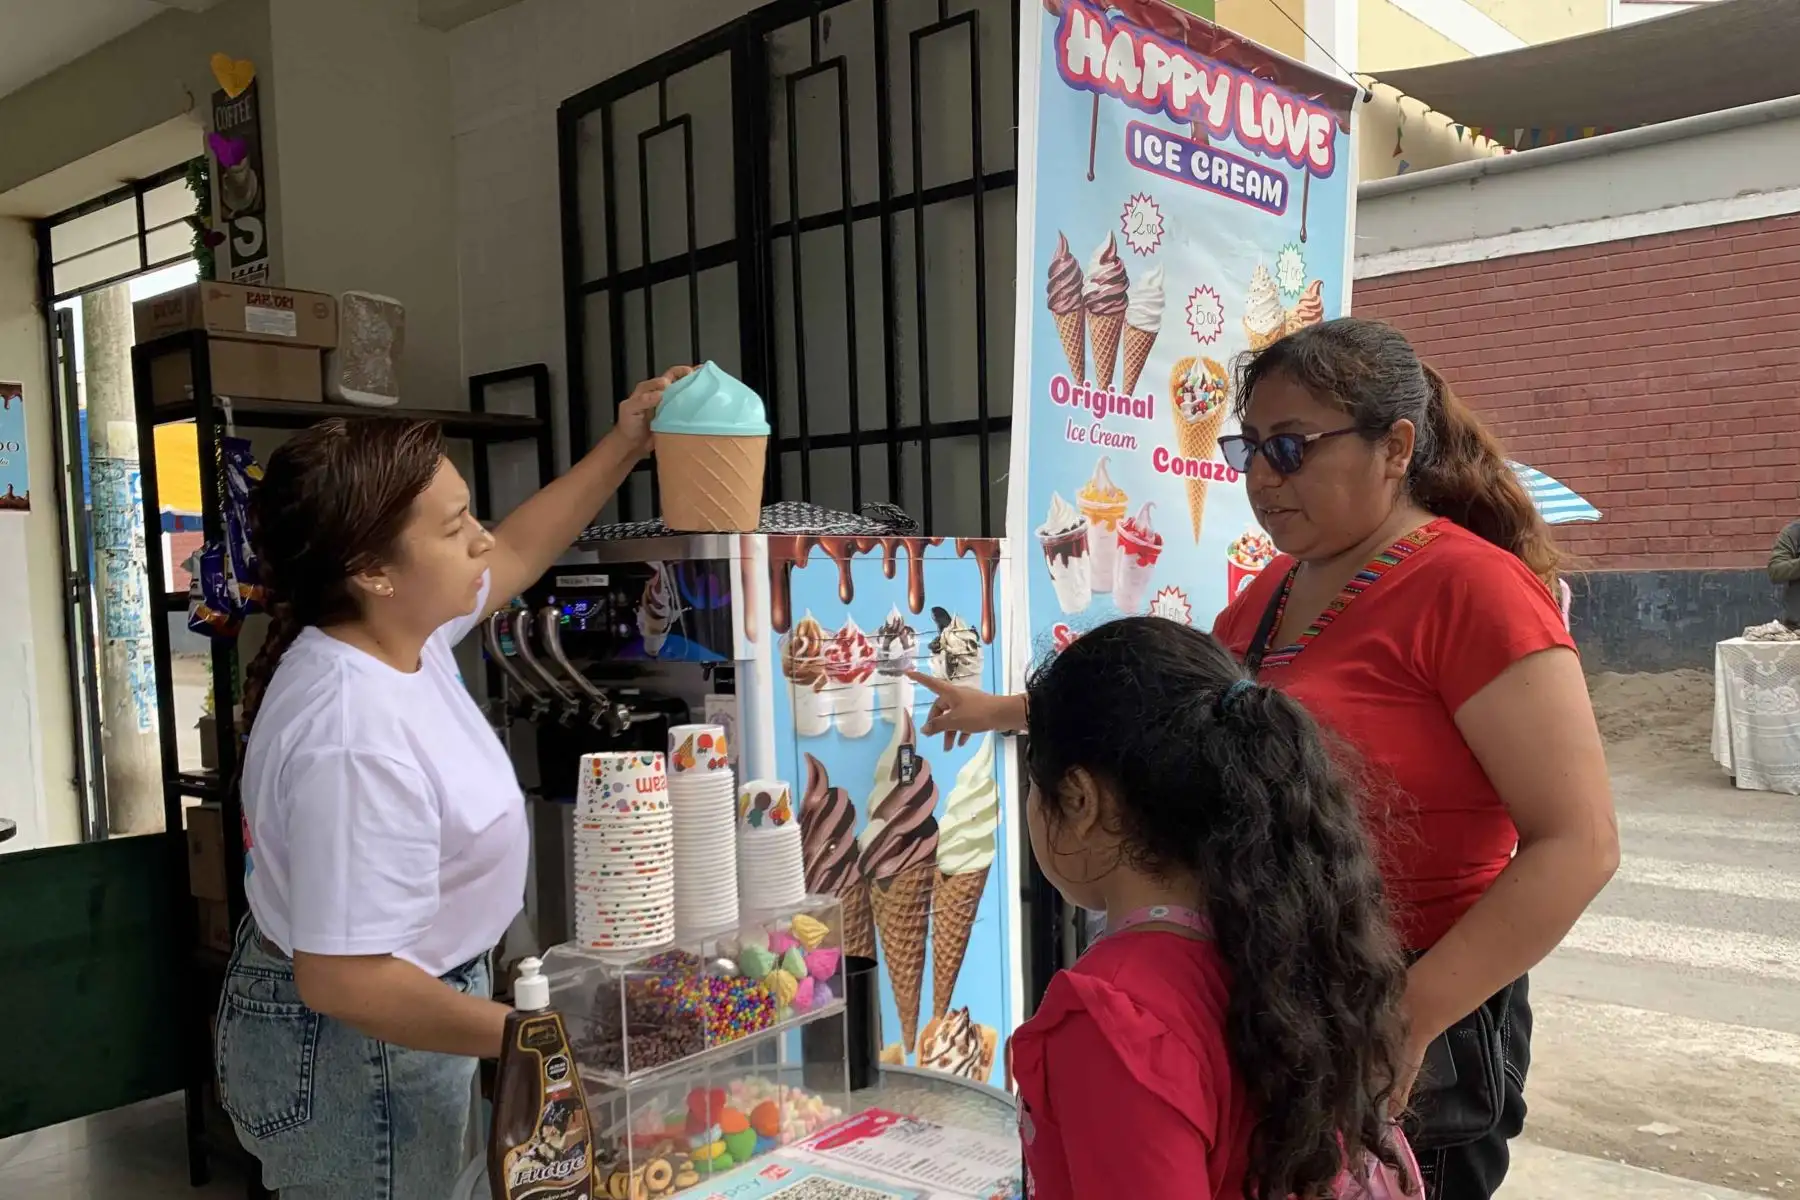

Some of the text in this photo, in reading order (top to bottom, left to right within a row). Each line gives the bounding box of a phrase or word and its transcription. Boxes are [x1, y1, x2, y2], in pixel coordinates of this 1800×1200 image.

[1064, 7, 1332, 167] HAPPY LOVE
[216, 95, 251, 130] COFFEE
[1133, 129, 1284, 208] ICE CREAM
[1050, 375, 1155, 420] Original
[1066, 418, 1138, 451] Ice Cream
[1152, 446, 1239, 483] Conazo
[513, 1154, 587, 1188] Fudge
